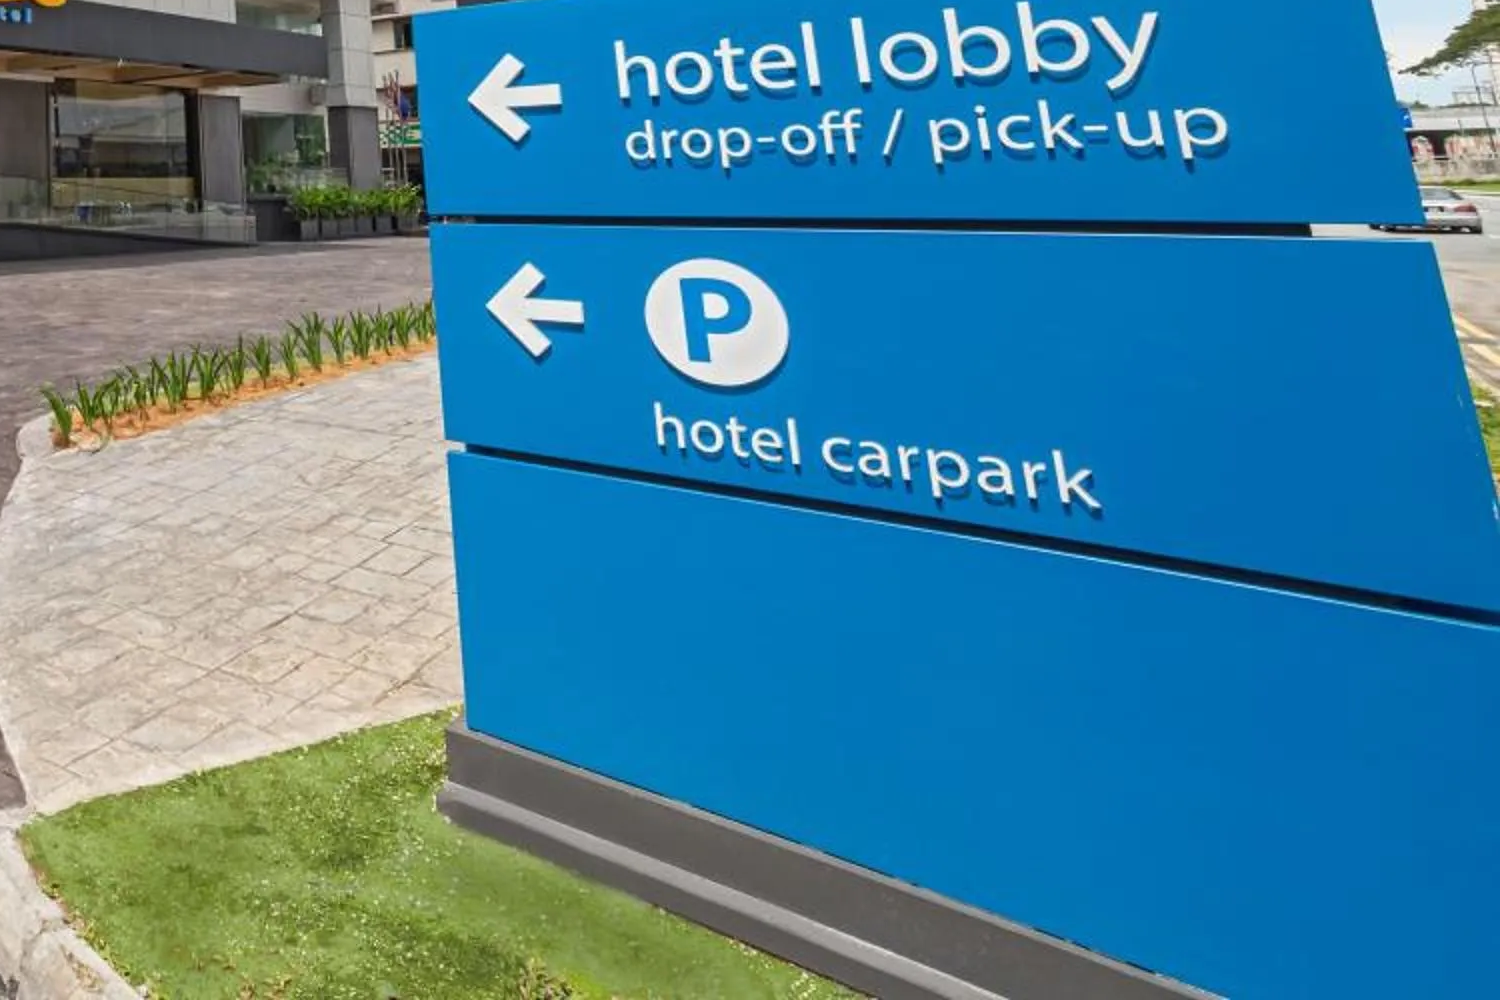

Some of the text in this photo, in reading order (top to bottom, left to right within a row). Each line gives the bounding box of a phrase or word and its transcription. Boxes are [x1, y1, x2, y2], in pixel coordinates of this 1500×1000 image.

[613, 1, 1160, 101] hotel lobby
[624, 108, 863, 170] drop-off
[929, 100, 1229, 166] pick-up
[678, 277, 753, 363] P
[653, 402, 1102, 512] hotel carpark
